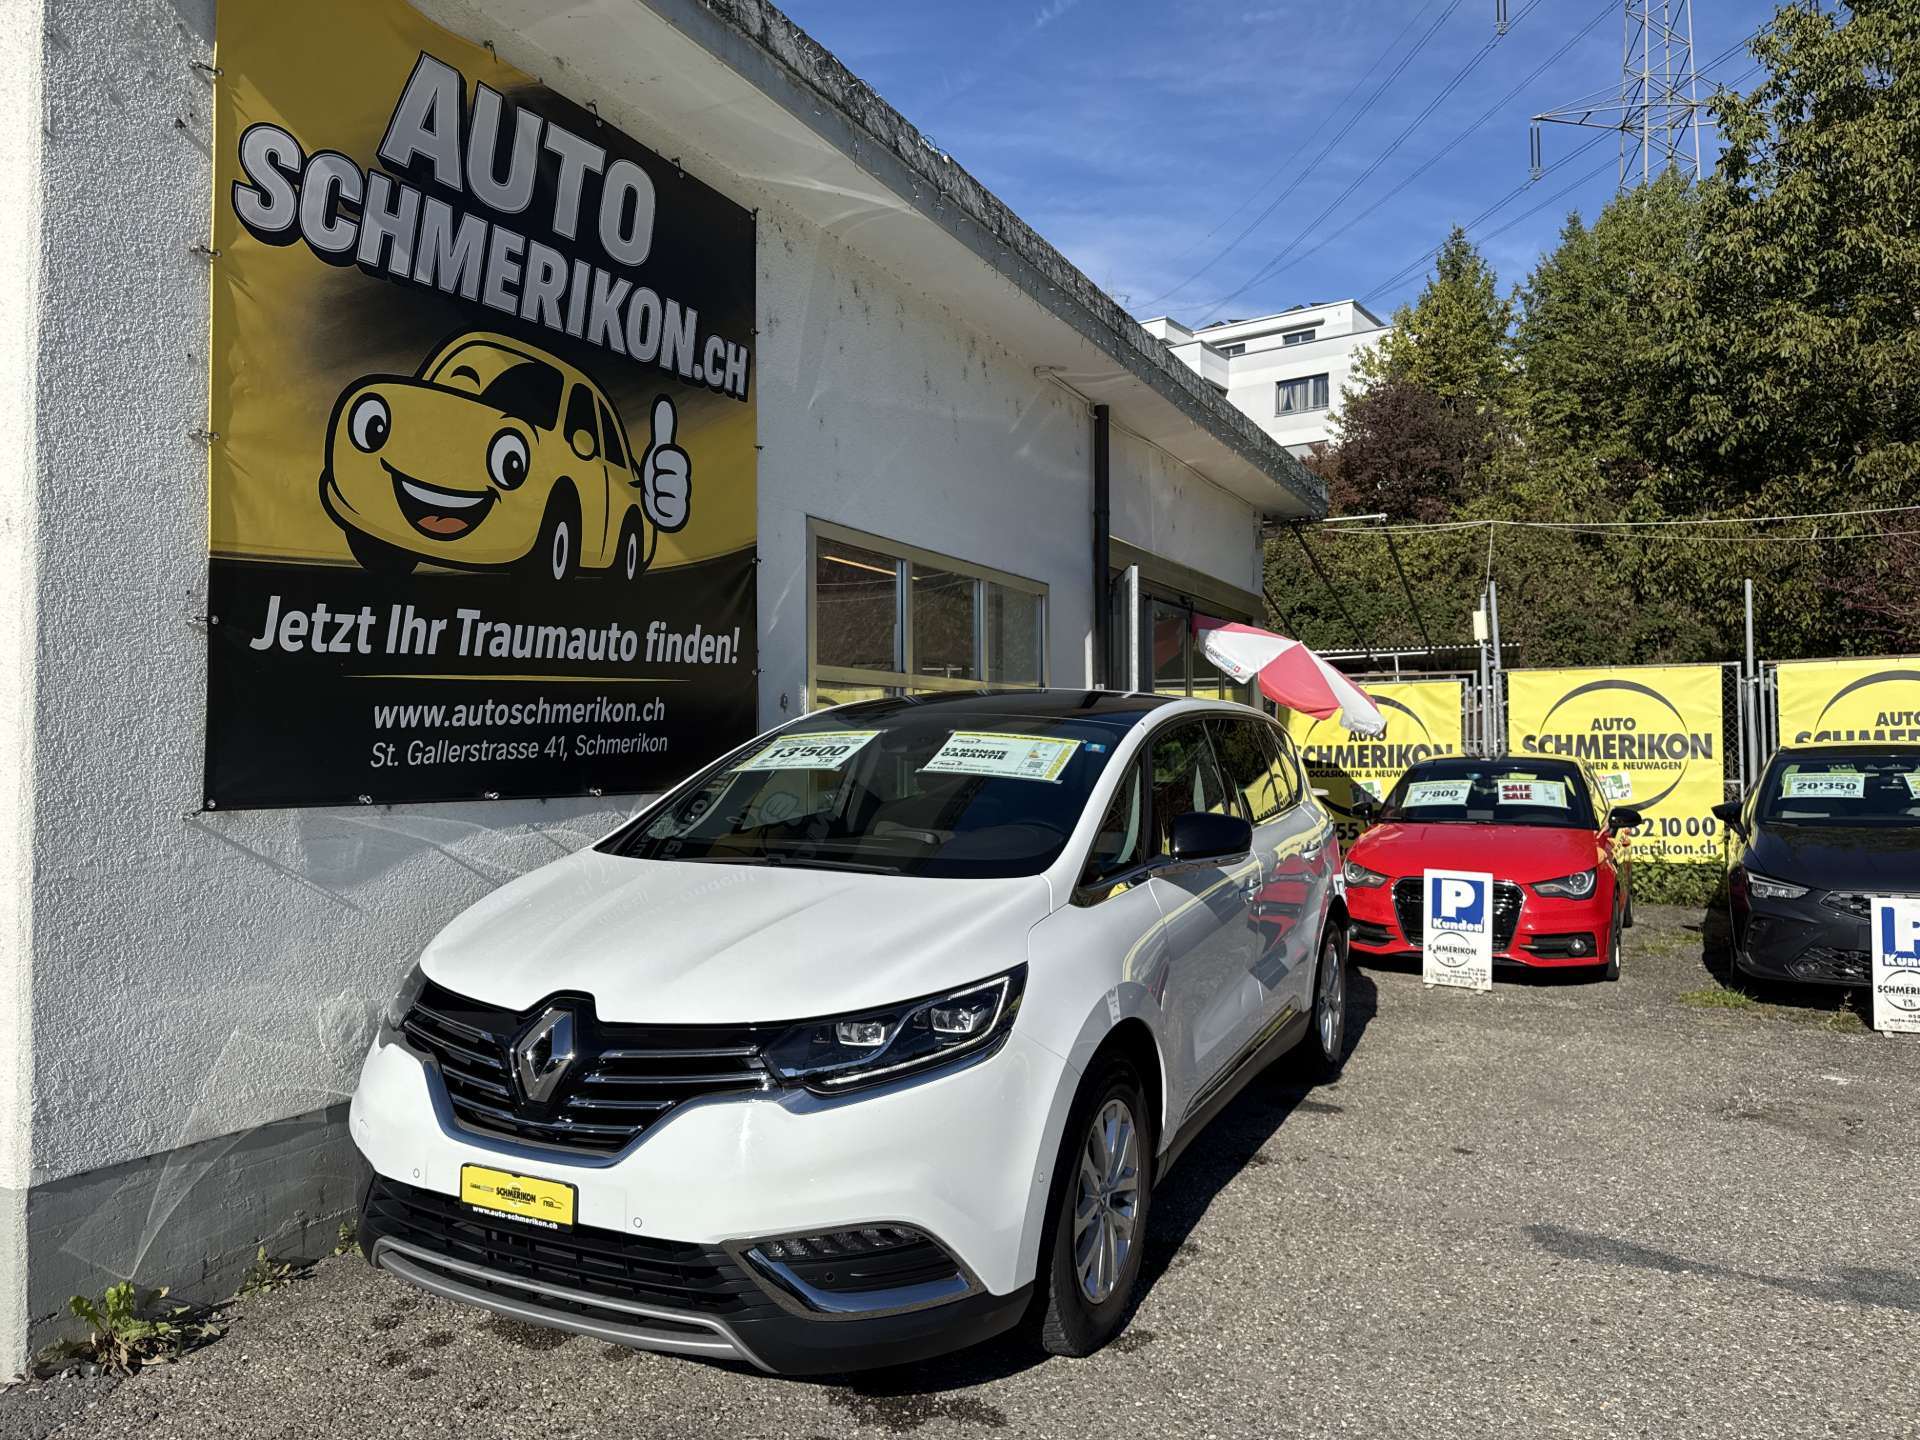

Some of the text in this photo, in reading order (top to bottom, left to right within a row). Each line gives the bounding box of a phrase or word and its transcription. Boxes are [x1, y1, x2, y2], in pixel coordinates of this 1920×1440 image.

[379, 51, 656, 268] AUTO
[233, 124, 750, 399] SCHMERIKON.CH
[249, 595, 740, 665] Jetzt Ihr Traumauto finden!
[374, 697, 665, 729] www.autoschmerikon.ch
[1590, 717, 1636, 731] AUTO
[370, 734, 667, 768] St. Gallerstrasse 41, Schmerikon
[769, 745, 850, 759] 13'500
[958, 748, 1009, 756] MONATE
[1522, 733, 1713, 760] SCHMERIKON
[940, 751, 1007, 761] GARANTIE
[1364, 769, 1372, 778] &
[1611, 762, 1619, 770] &
[1623, 761, 1682, 771] NEUWAGEN
[1420, 789, 1459, 799] 7'800
[1502, 784, 1533, 792] SALE
[1796, 782, 1858, 791] 20'350
[1502, 792, 1533, 801] SALE
[1660, 817, 1682, 837] 10
[1685, 816, 1717, 836] 00
[1441, 879, 1475, 918] P
[496, 1186, 537, 1204] SCHMERIKON
[472, 1205, 559, 1230] www.auto-schmerikon.ch
